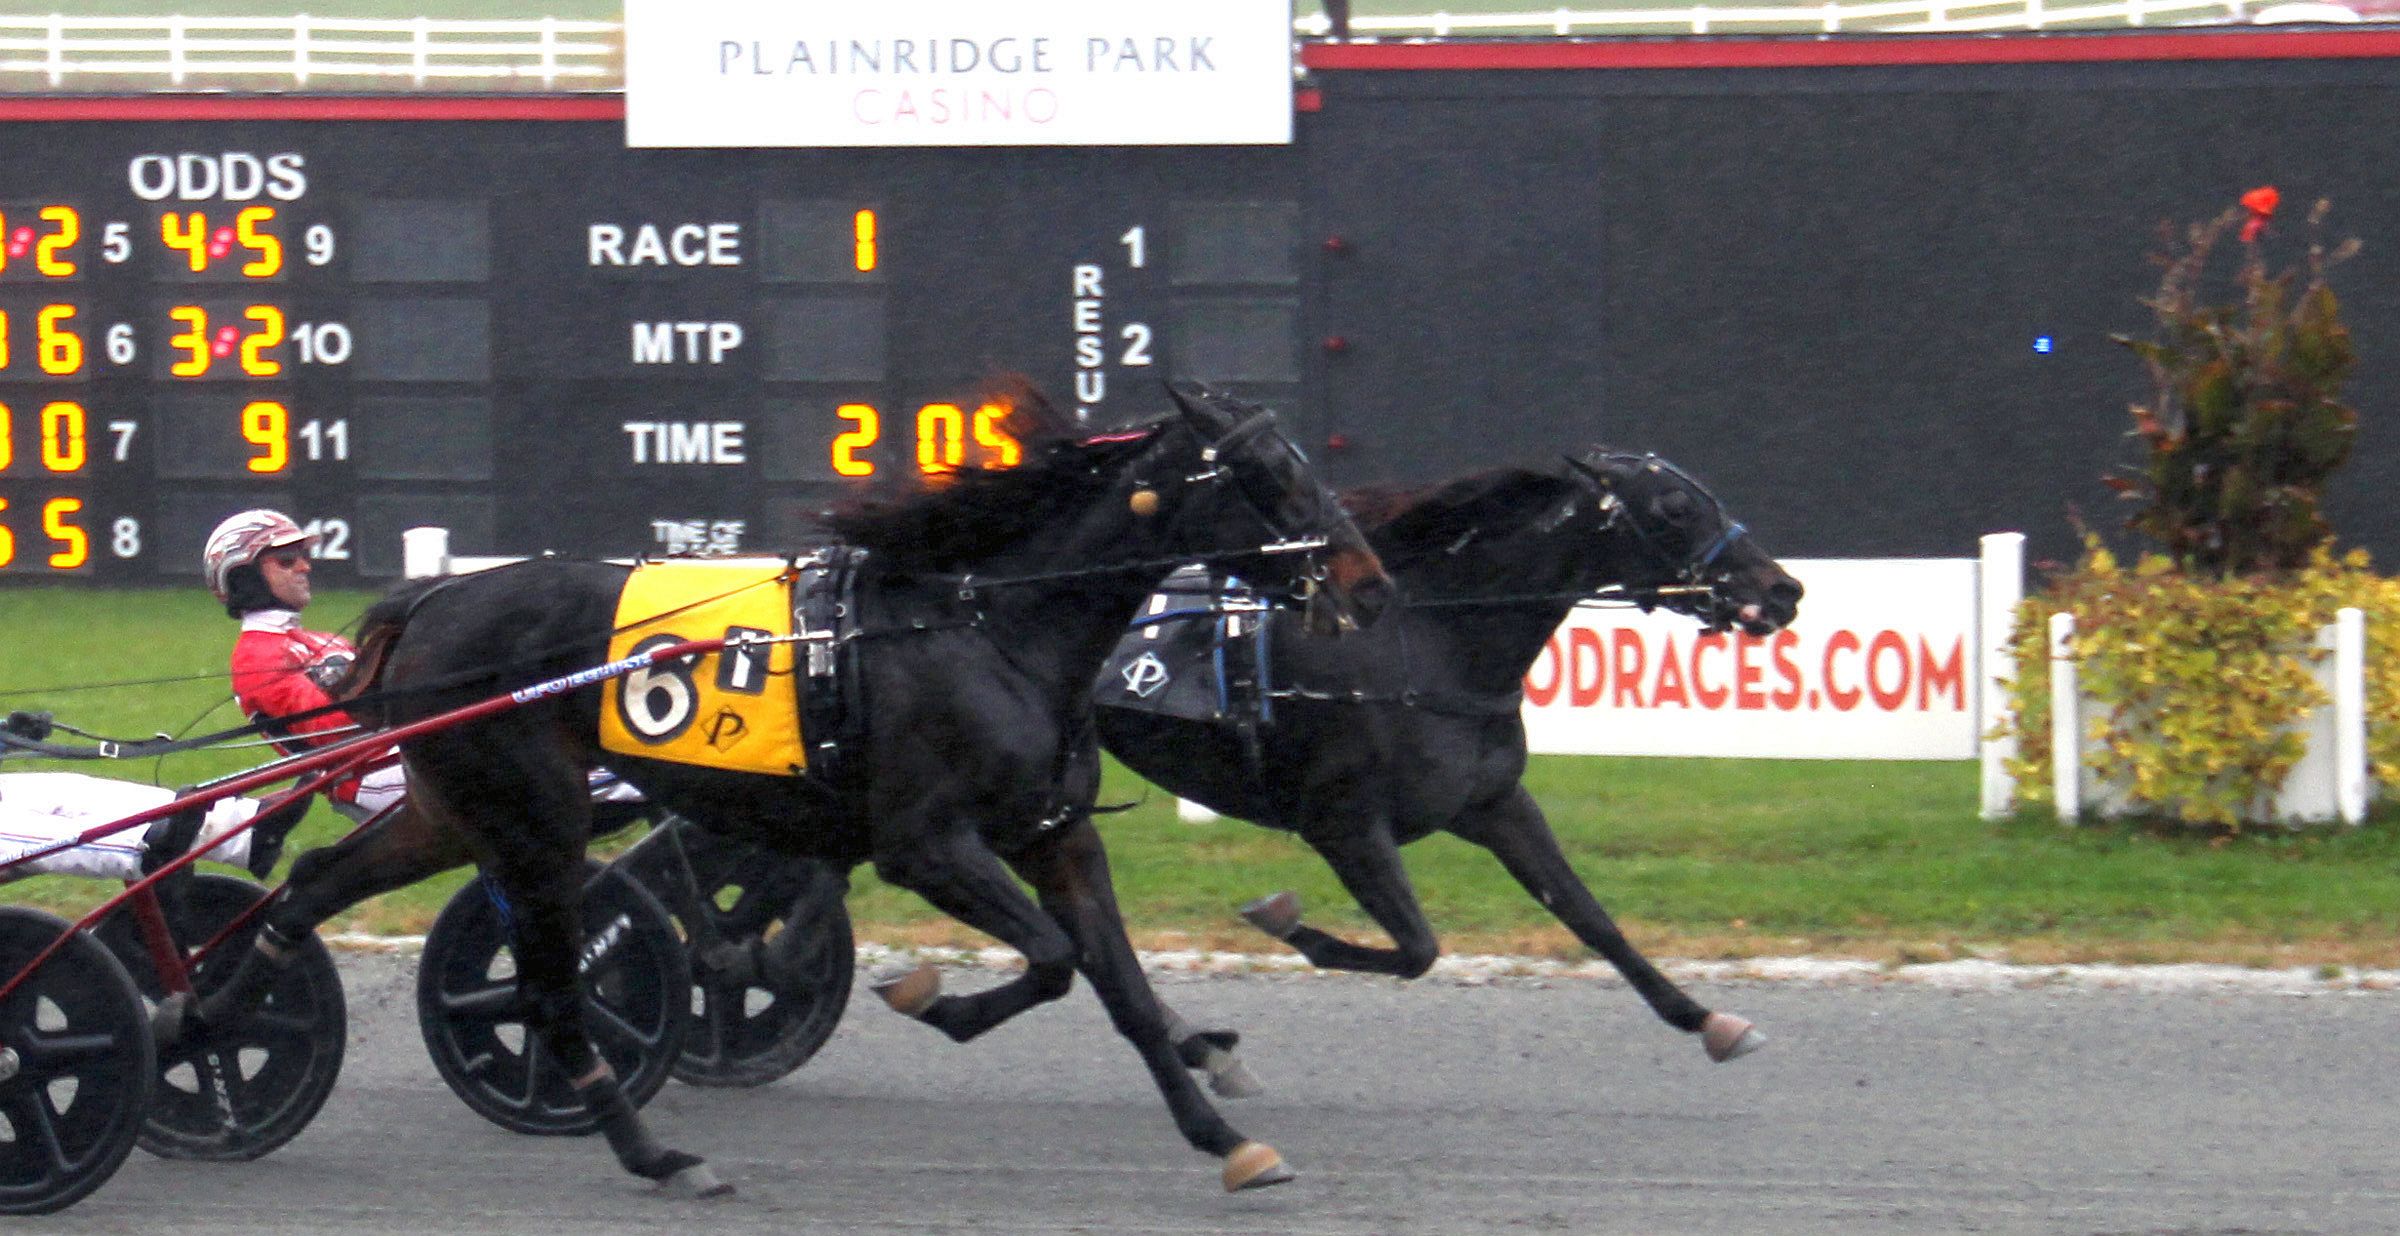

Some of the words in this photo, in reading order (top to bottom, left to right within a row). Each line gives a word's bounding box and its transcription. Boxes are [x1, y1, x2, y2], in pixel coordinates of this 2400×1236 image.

[719, 37, 1053, 75] PLAINRIDGE
[1086, 36, 1216, 73] PARK
[853, 87, 1058, 125] CASINO
[128, 152, 307, 201] ODDS
[102, 221, 133, 264] 5
[304, 223, 336, 266] 9
[588, 221, 742, 266] RACE
[853, 209, 878, 272] 1
[1120, 226, 1145, 268] 1
[106, 322, 136, 365] 6
[290, 321, 353, 365] 10
[631, 320, 744, 364] MTP
[1120, 322, 1153, 366] 2
[108, 420, 138, 462] 7
[240, 400, 290, 473] 9
[298, 419, 348, 461] 11
[622, 420, 746, 464] TIME
[111, 516, 141, 558] 8
[623, 641, 693, 737] 6
